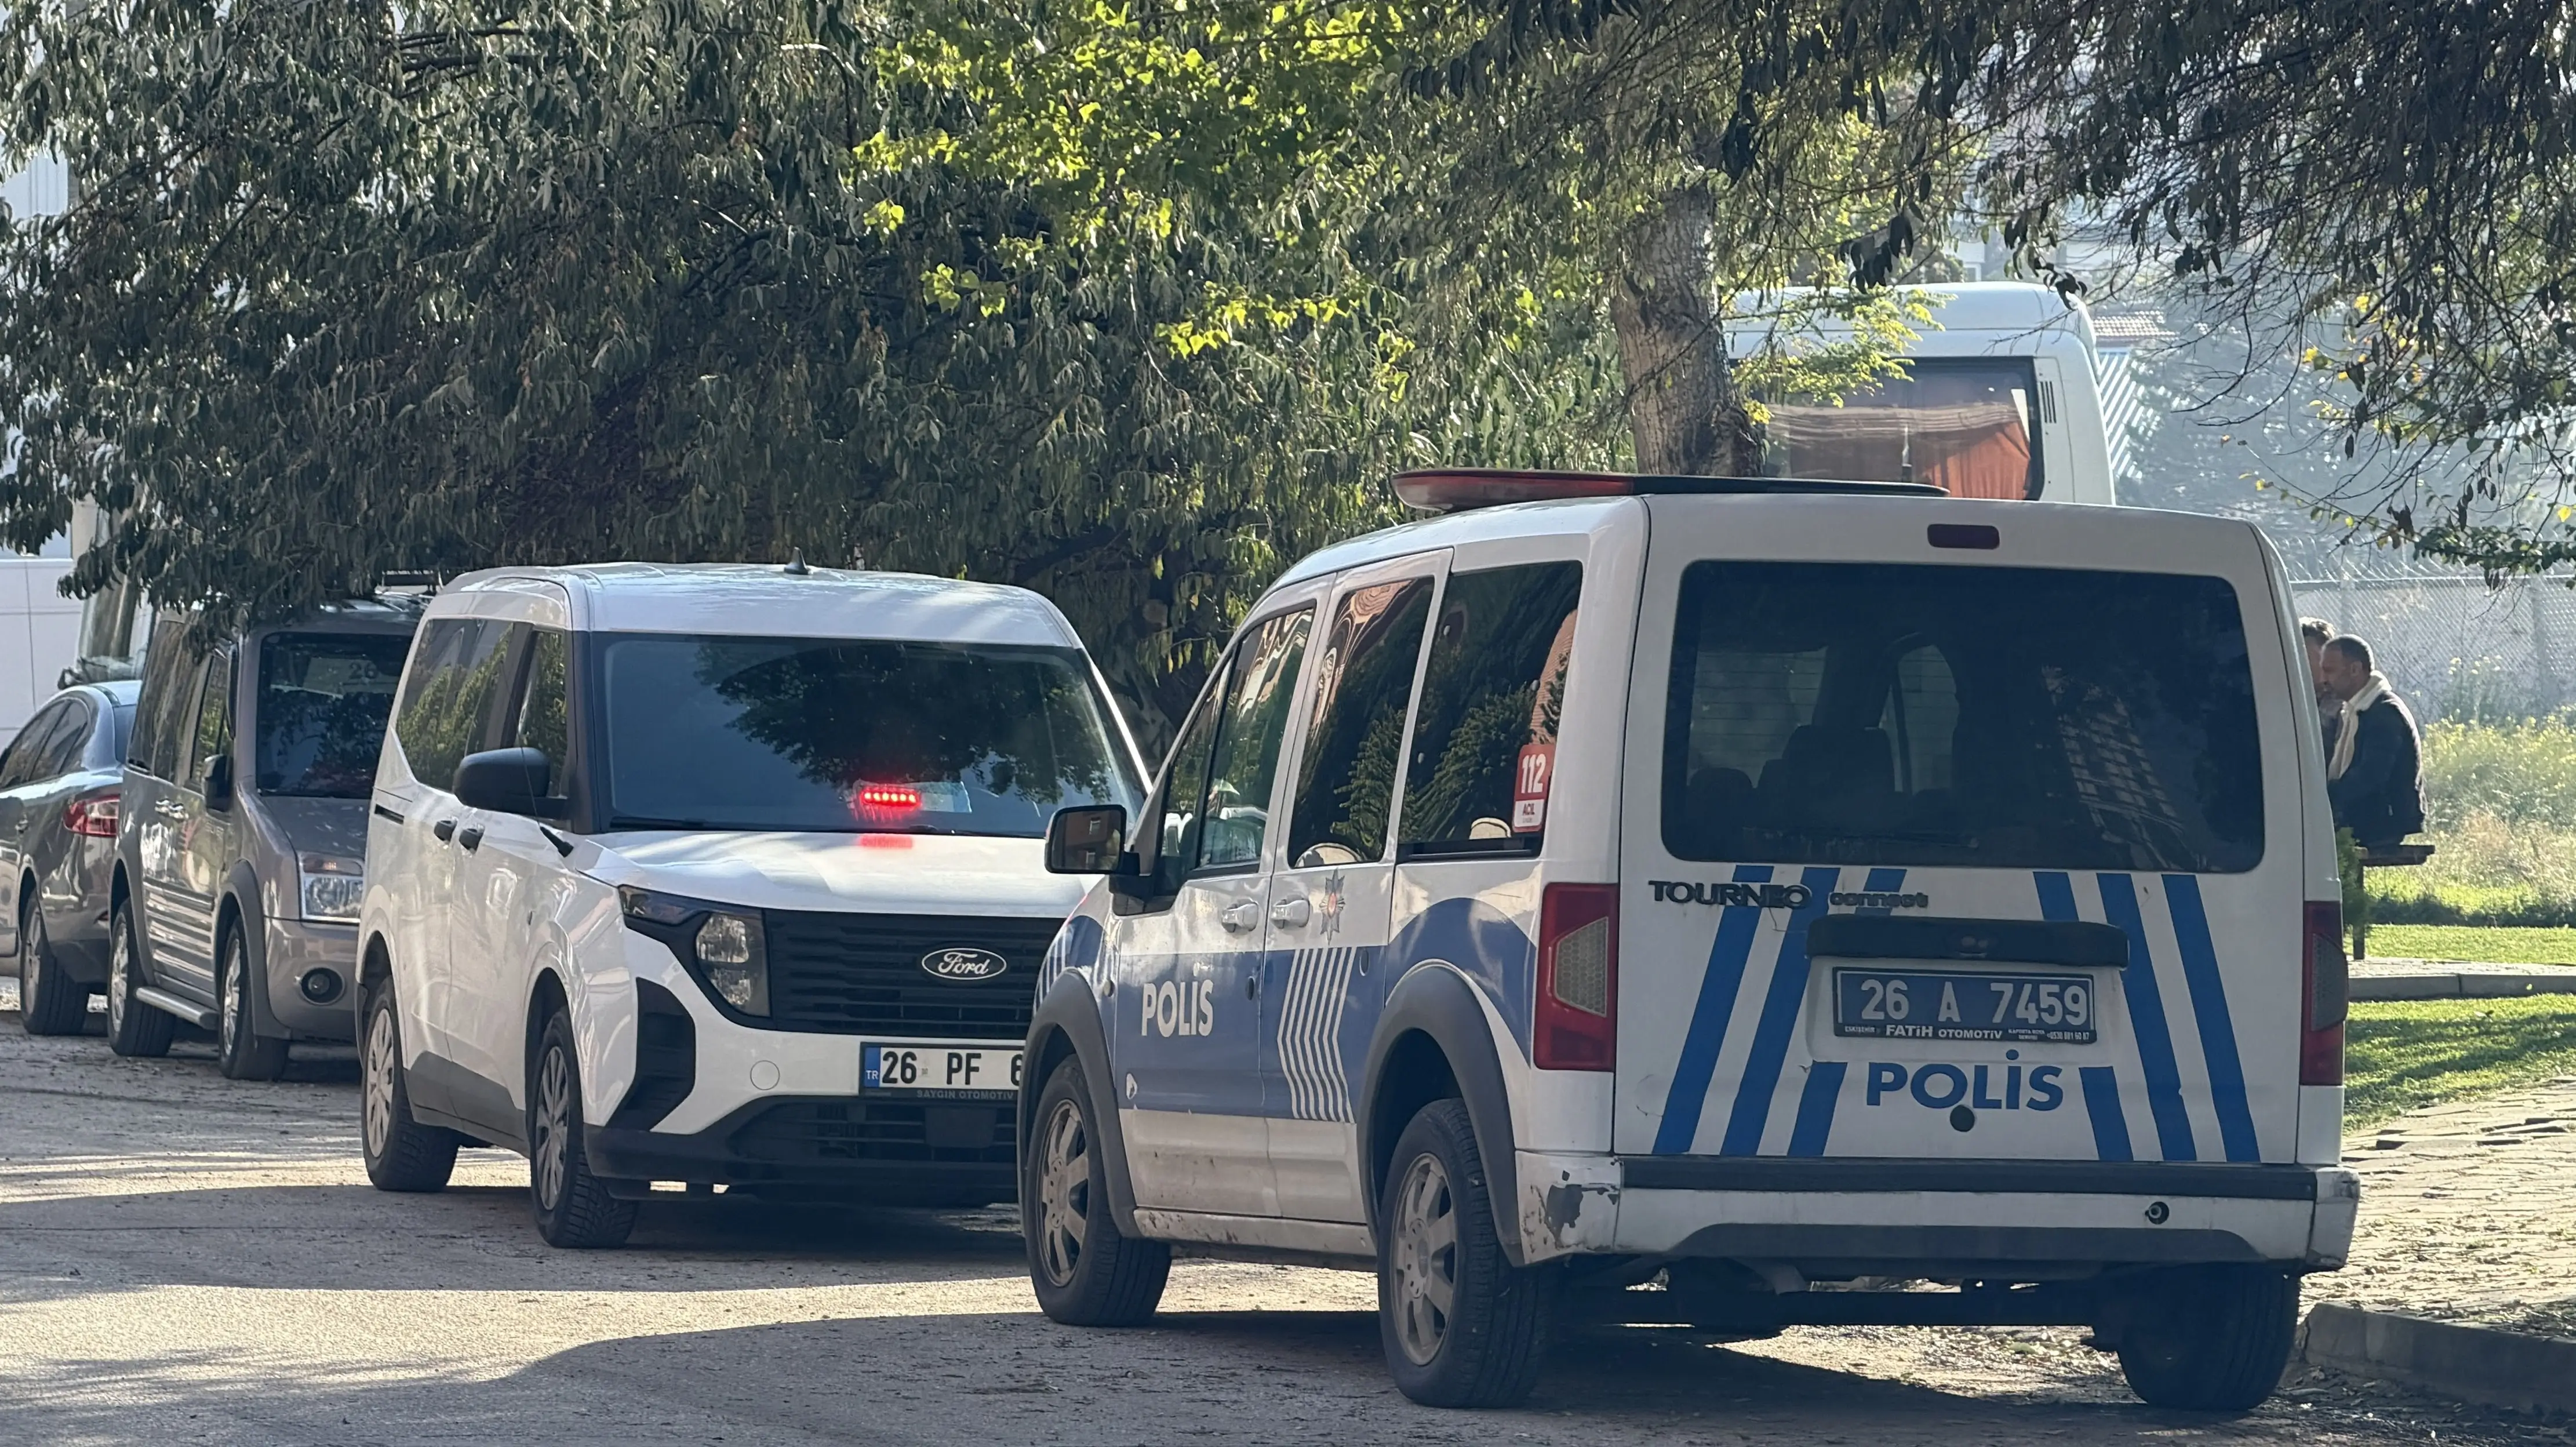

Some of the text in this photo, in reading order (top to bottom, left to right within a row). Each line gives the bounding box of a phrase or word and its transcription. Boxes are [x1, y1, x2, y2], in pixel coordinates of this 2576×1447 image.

[1521, 754, 1547, 794] 112
[1649, 880, 1813, 910] TOURNEO
[938, 951, 991, 975] Ford
[1861, 979, 2087, 1026] 26 A 7459
[866, 1070, 879, 1080] TR
[882, 1051, 918, 1084] 26
[947, 1052, 982, 1085] PF
[1866, 1049, 2064, 1111] POLİS
